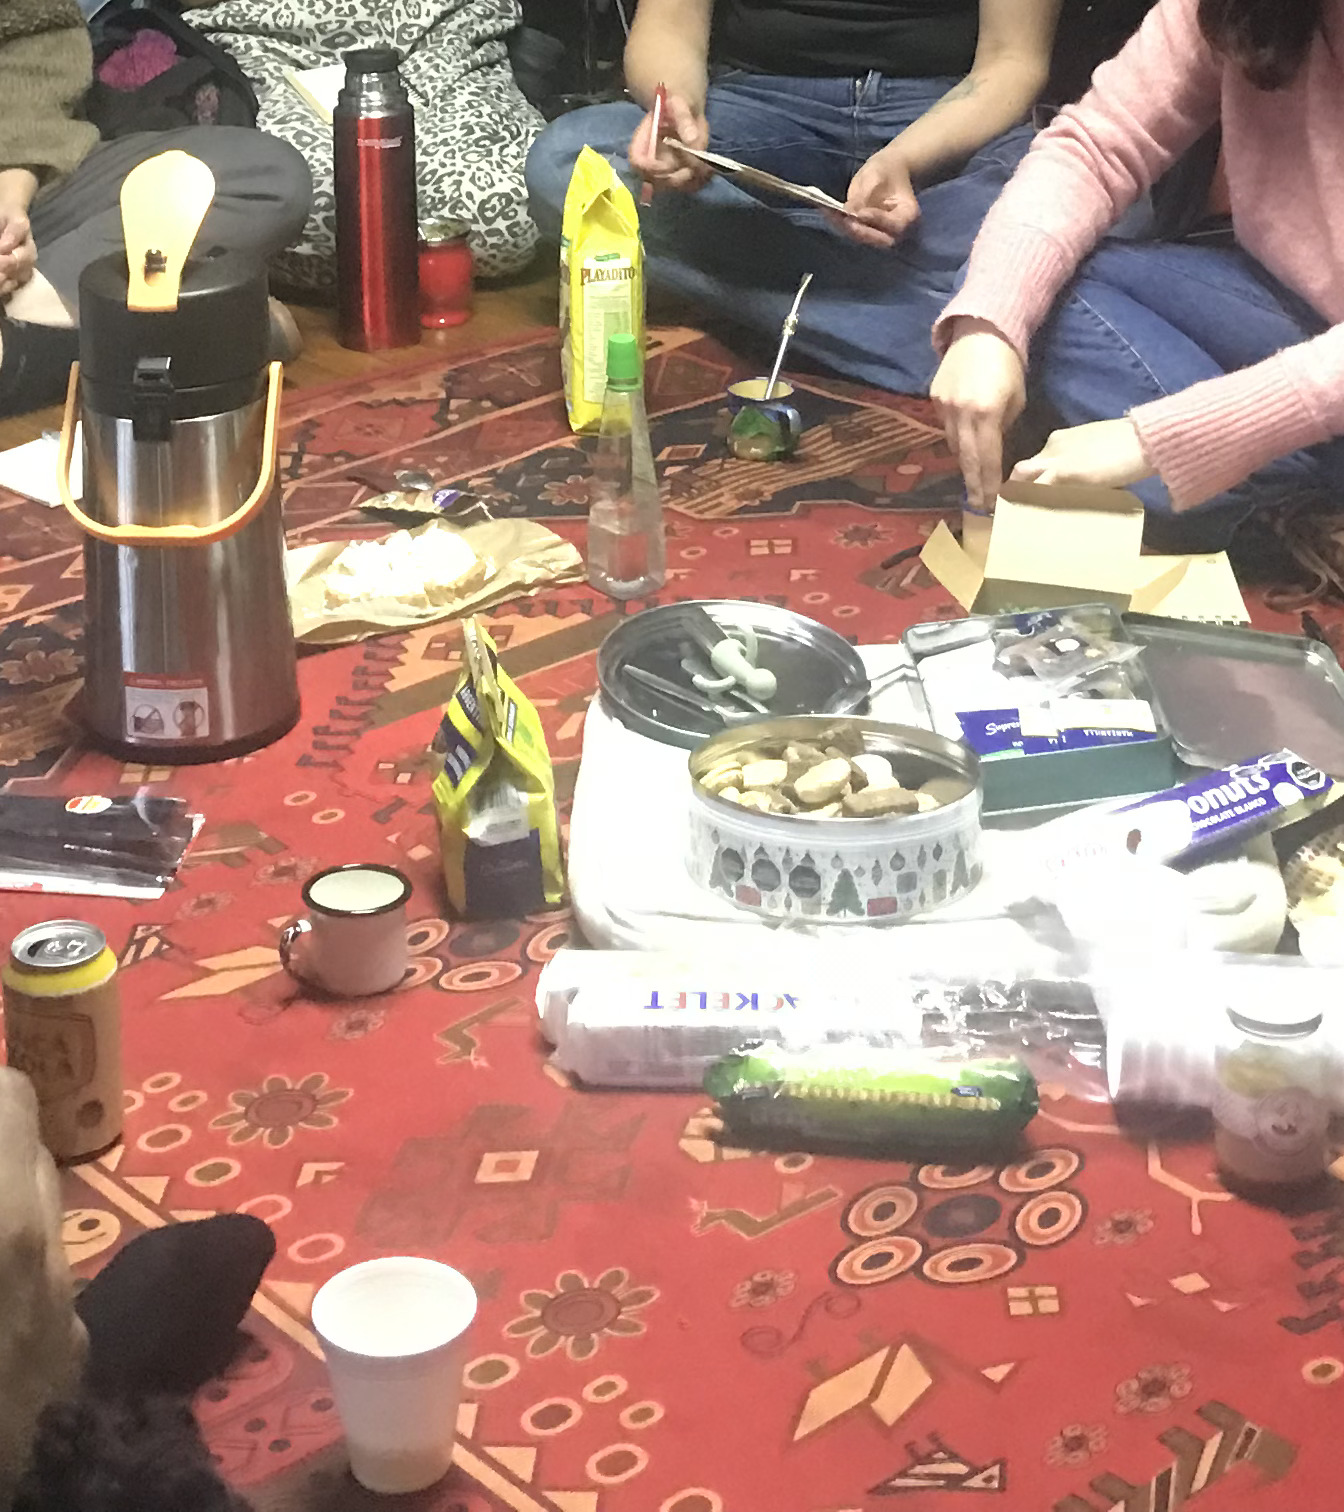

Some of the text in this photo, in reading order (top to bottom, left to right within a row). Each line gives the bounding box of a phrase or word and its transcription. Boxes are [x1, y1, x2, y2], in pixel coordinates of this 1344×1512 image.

[580, 266, 637, 286] PLAYADITO
[985, 721, 1021, 736] Supre
[1186, 774, 1271, 815] onuts
